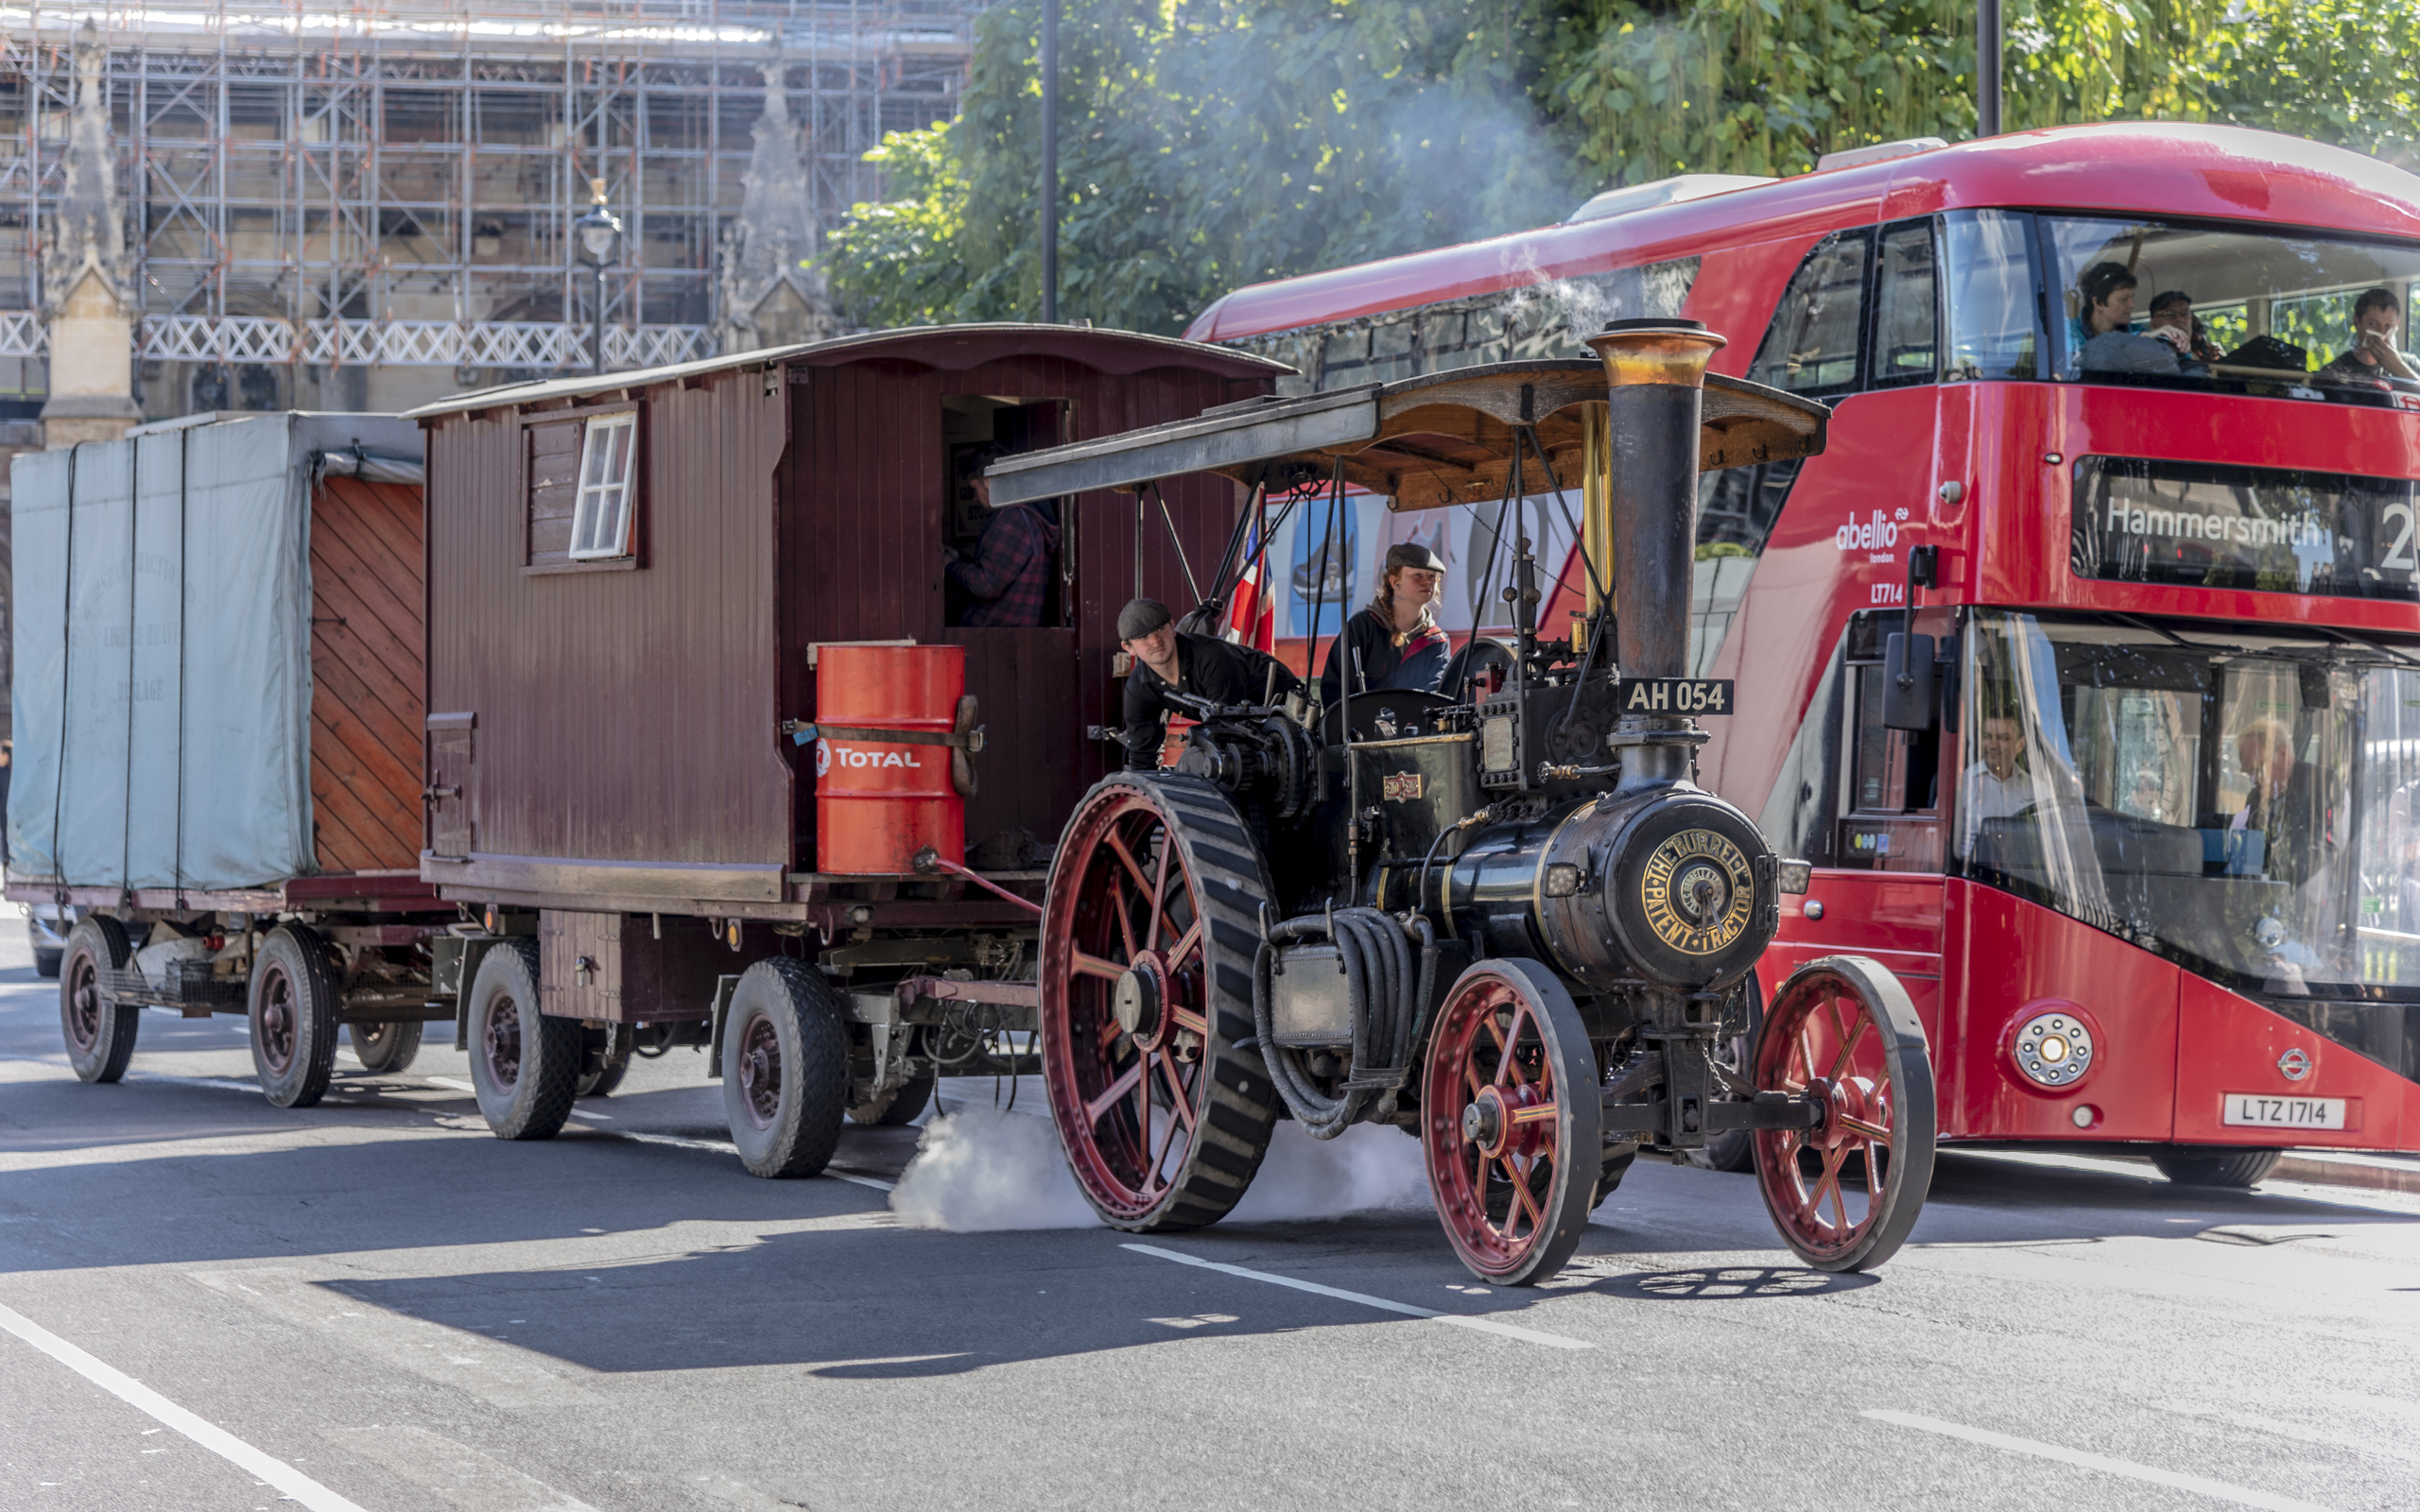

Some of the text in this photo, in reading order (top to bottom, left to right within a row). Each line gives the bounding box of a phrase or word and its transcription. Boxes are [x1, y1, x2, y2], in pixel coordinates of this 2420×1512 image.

[1836, 508, 1897, 551] abellio
[2106, 496, 2319, 548] Hammersmith
[1870, 552, 1894, 563] london
[1871, 583, 1903, 604] LT714
[1627, 681, 1725, 711] AH 054
[836, 747, 921, 768] TOTAL
[1647, 847, 1679, 882] THE
[1646, 886, 1695, 948] PATENT
[1701, 885, 1752, 951] TRACTOR
[2242, 1099, 2326, 1124] LTZ 1714
